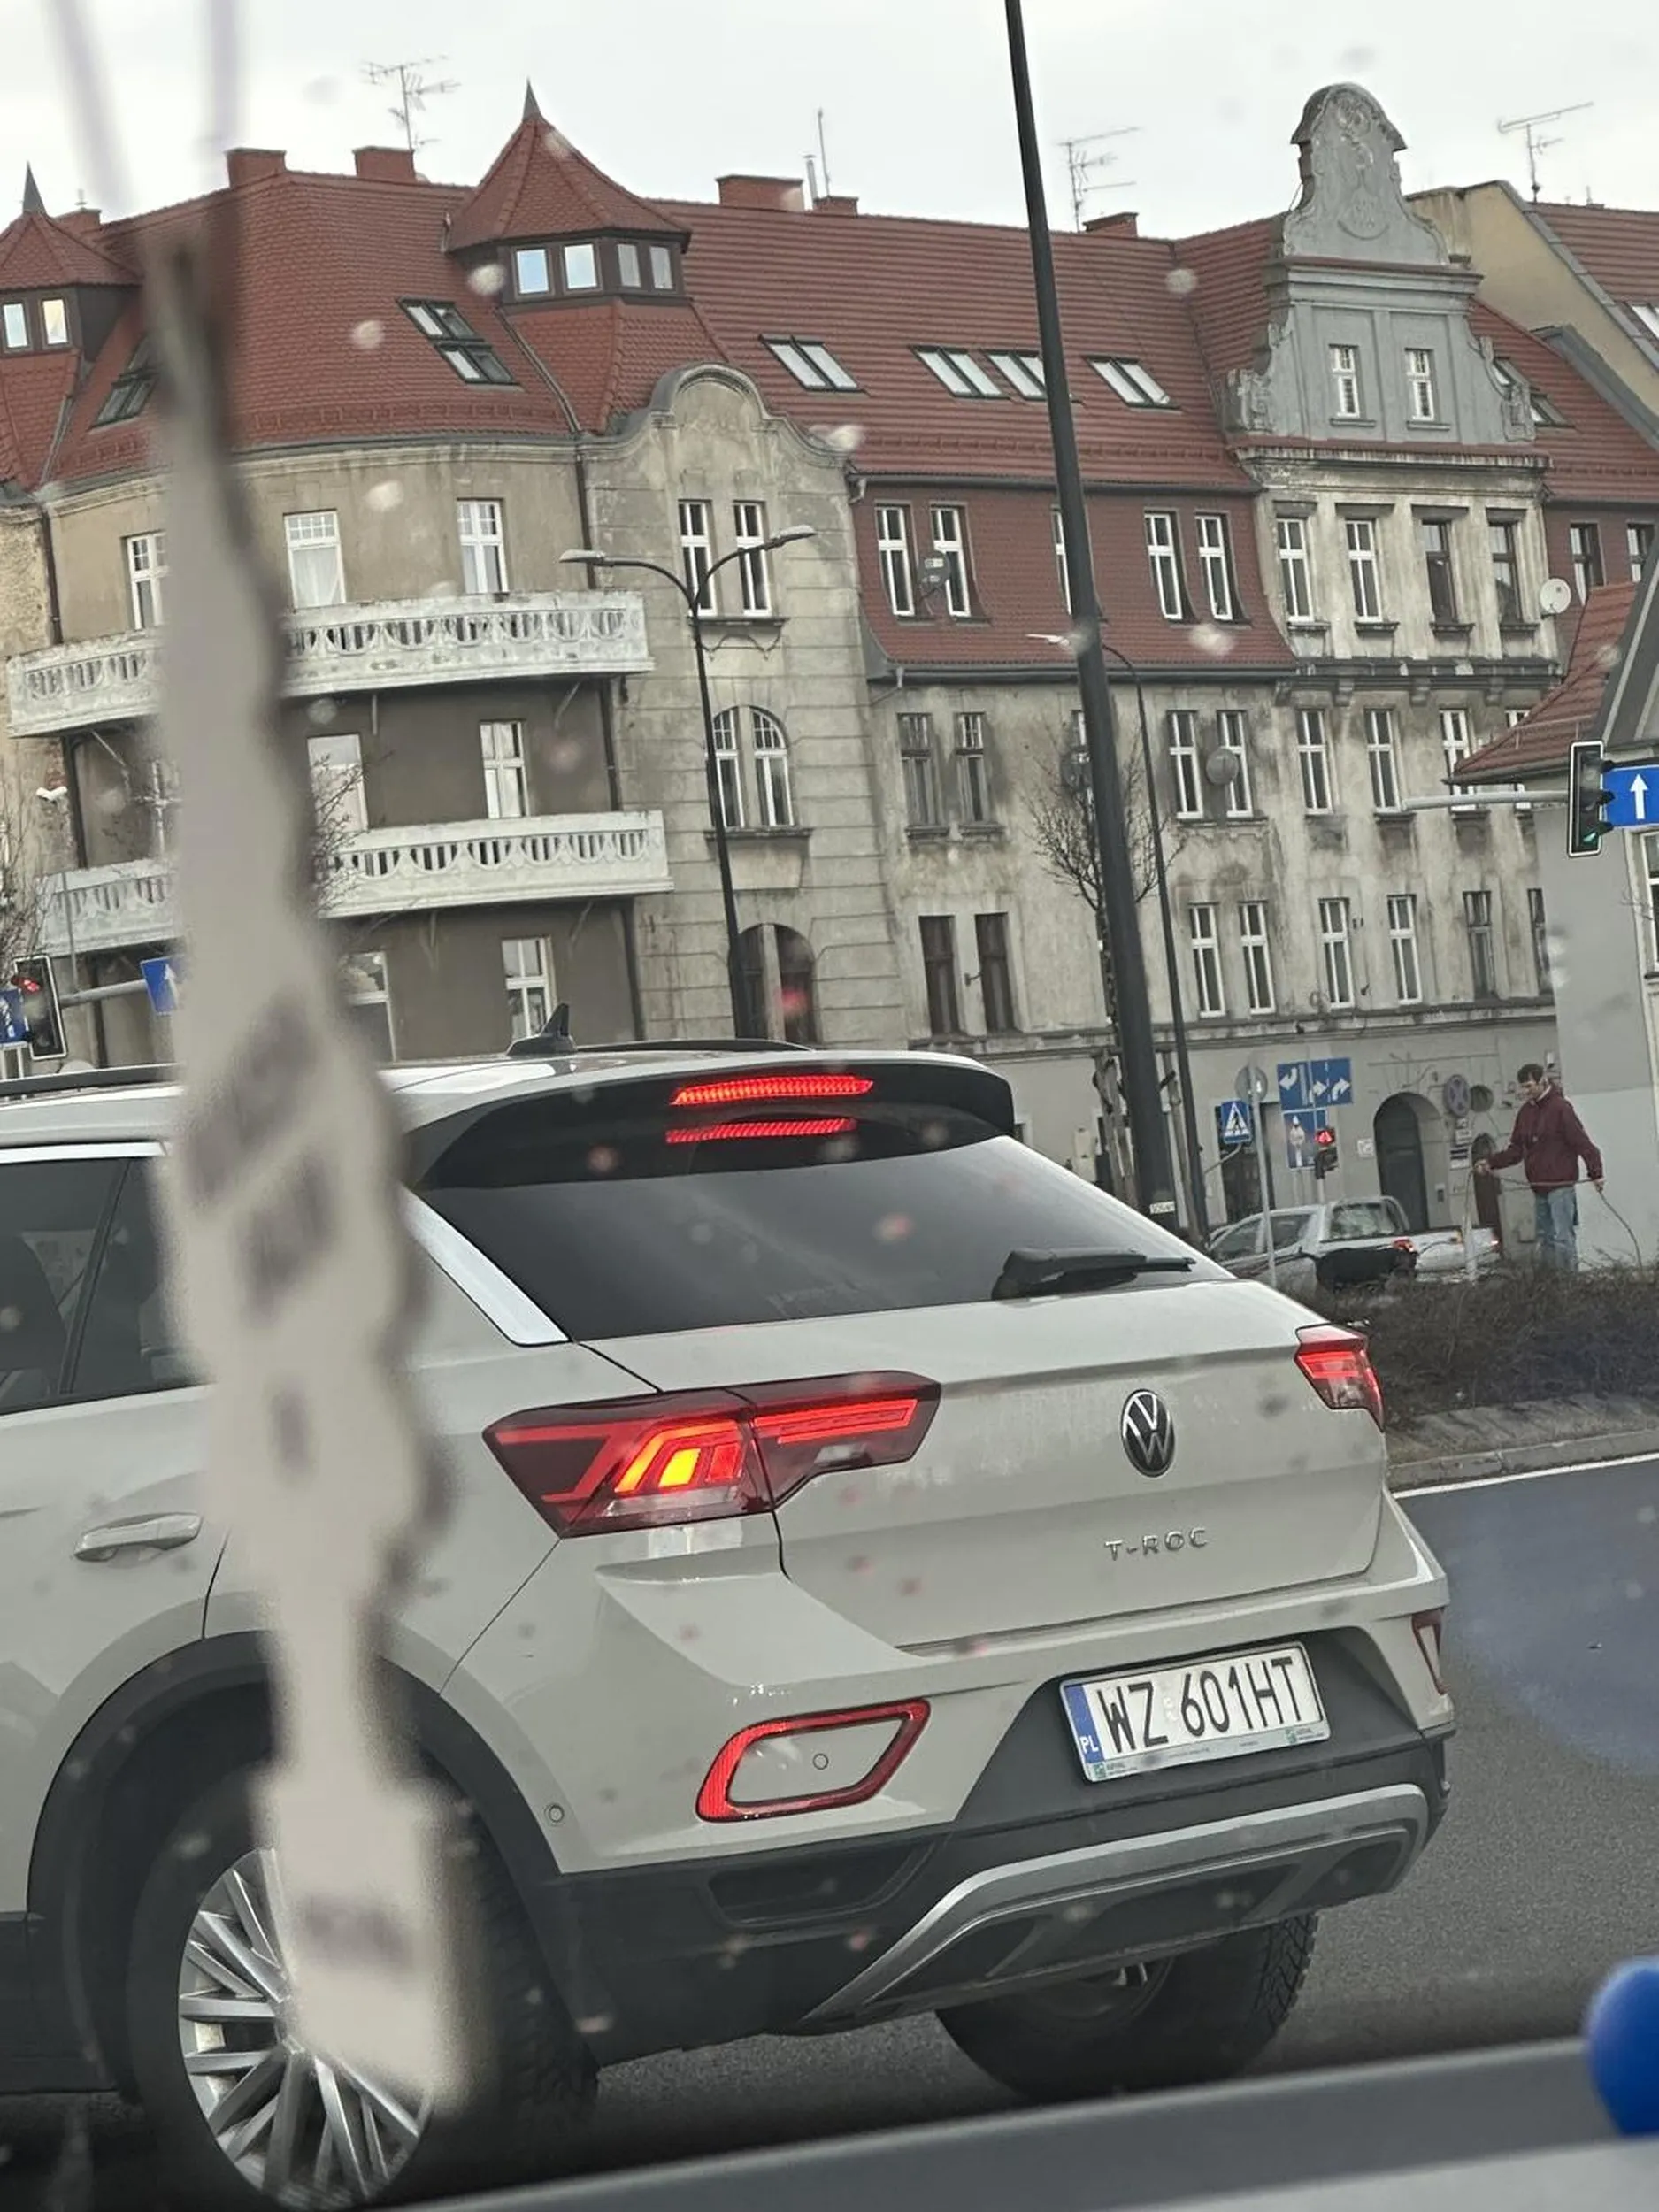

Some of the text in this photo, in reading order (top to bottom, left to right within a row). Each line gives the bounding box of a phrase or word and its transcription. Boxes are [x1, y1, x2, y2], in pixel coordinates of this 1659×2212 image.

[1104, 1527, 1208, 1561] T-ROC
[1097, 1656, 1301, 1754] WZ 601HT
[1080, 1735, 1099, 1755] PL
